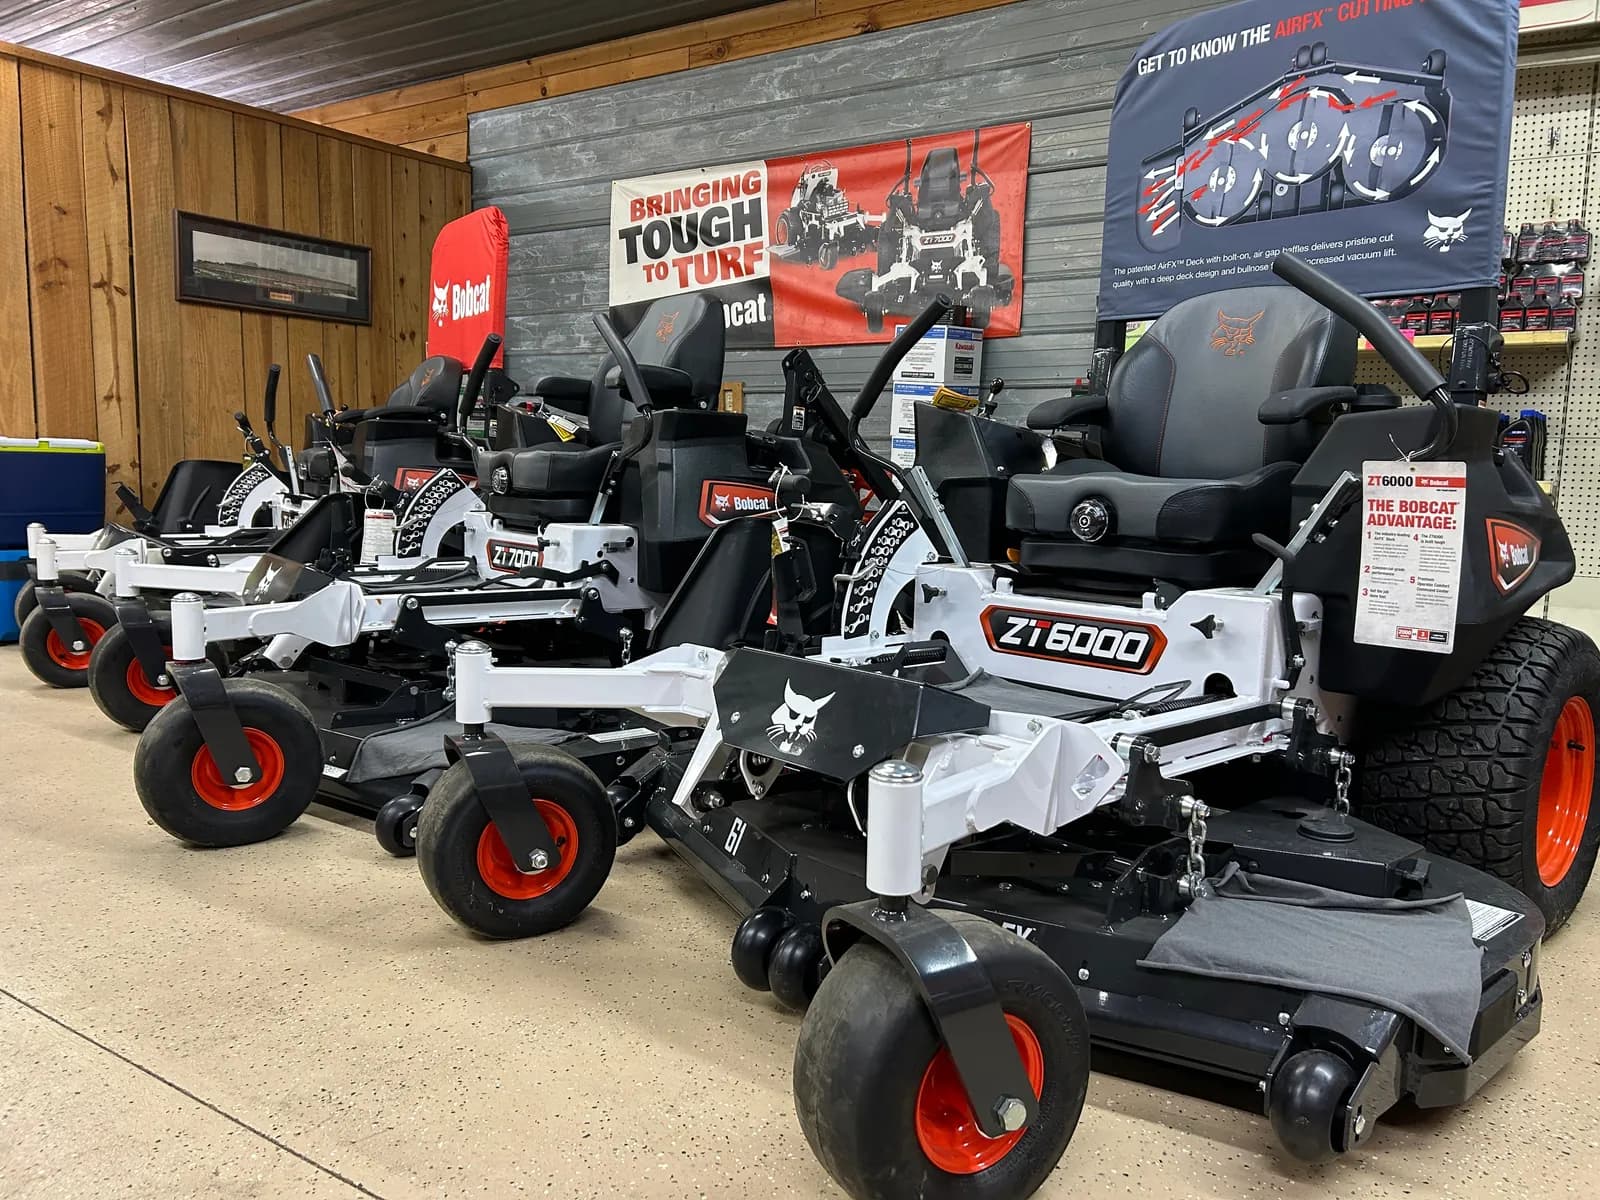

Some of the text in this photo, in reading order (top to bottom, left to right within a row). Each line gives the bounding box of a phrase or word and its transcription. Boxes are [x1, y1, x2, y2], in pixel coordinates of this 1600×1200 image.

[1138, 54, 1165, 75] GET
[1168, 47, 1186, 68] TO
[1190, 33, 1237, 62] KNOW
[1241, 23, 1271, 47] THE
[630, 170, 761, 222] BRINGING
[618, 197, 763, 265] TOUGH
[643, 241, 764, 289] TO TURF
[1114, 267, 1125, 276] The
[1127, 264, 1156, 275] patented
[1186, 257, 1204, 267] Deck
[1206, 255, 1220, 264] with
[1223, 252, 1251, 262] bolt-on,
[1253, 250, 1263, 259] air
[1265, 249, 1280, 260] gap
[1311, 240, 1343, 251] delivers
[1345, 236, 1377, 248] pristine
[1379, 233, 1394, 243] cut
[1112, 280, 1134, 289] quality
[1136, 277, 1149, 286] with
[1157, 274, 1174, 284] deep
[1176, 271, 1194, 281] deck
[1195, 269, 1219, 279] design
[1221, 267, 1235, 276] and
[1237, 263, 1268, 274] bullnose
[1347, 251, 1381, 261] vacuum
[1383, 248, 1397, 257] lift.
[452, 275, 490, 320] Bobcat
[1368, 475, 1413, 487] ZT6000
[733, 496, 769, 511] Bobcat
[1367, 499, 1394, 512] THE
[1367, 513, 1457, 530] ADVANTAGE:
[1367, 531, 1372, 539] 1
[493, 545, 538, 568] ZT7000
[1510, 543, 1529, 566] Bobcat
[1364, 565, 1370, 573] 2
[1410, 576, 1416, 584] 5
[1362, 588, 1368, 596] 3
[999, 616, 1149, 662] ZT6000
[724, 816, 747, 857] 61
